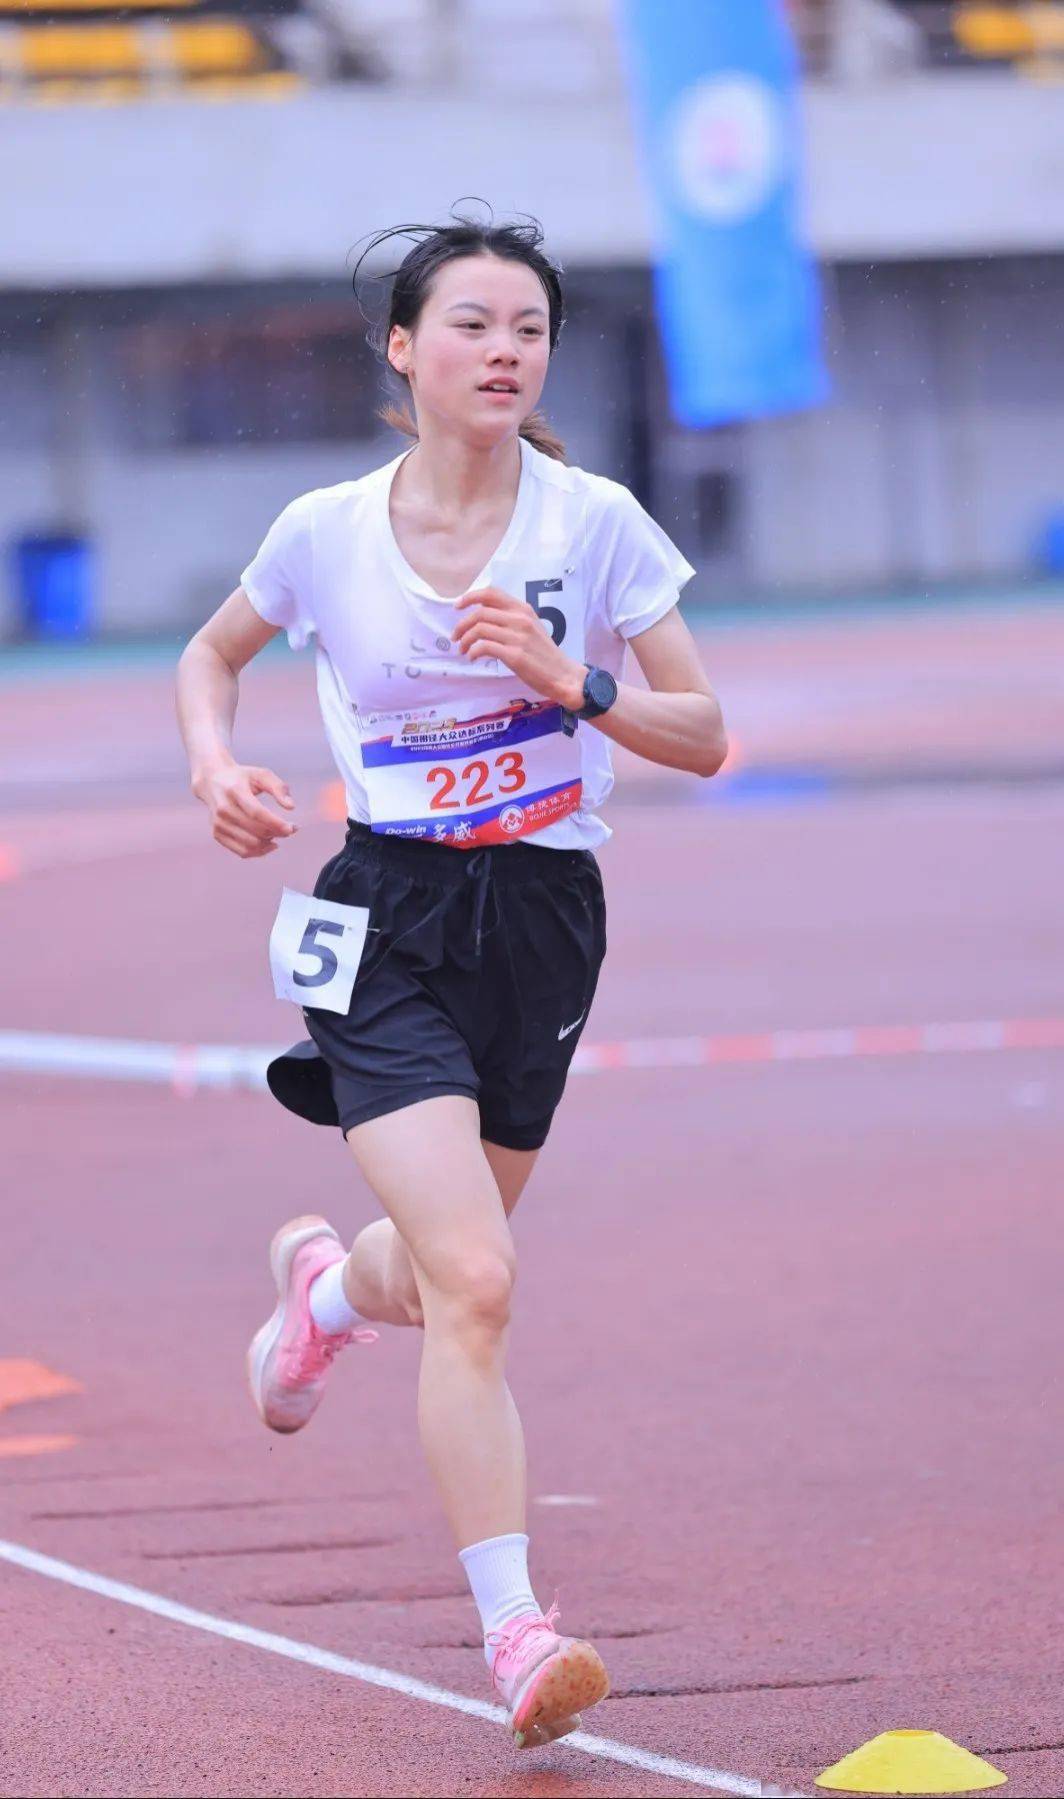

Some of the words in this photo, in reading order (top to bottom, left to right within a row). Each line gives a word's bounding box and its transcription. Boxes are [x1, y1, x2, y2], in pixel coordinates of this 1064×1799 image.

[525, 578, 567, 648] 5
[426, 752, 527, 811] 223
[433, 820, 477, 842] 多威
[292, 917, 346, 988] 5
